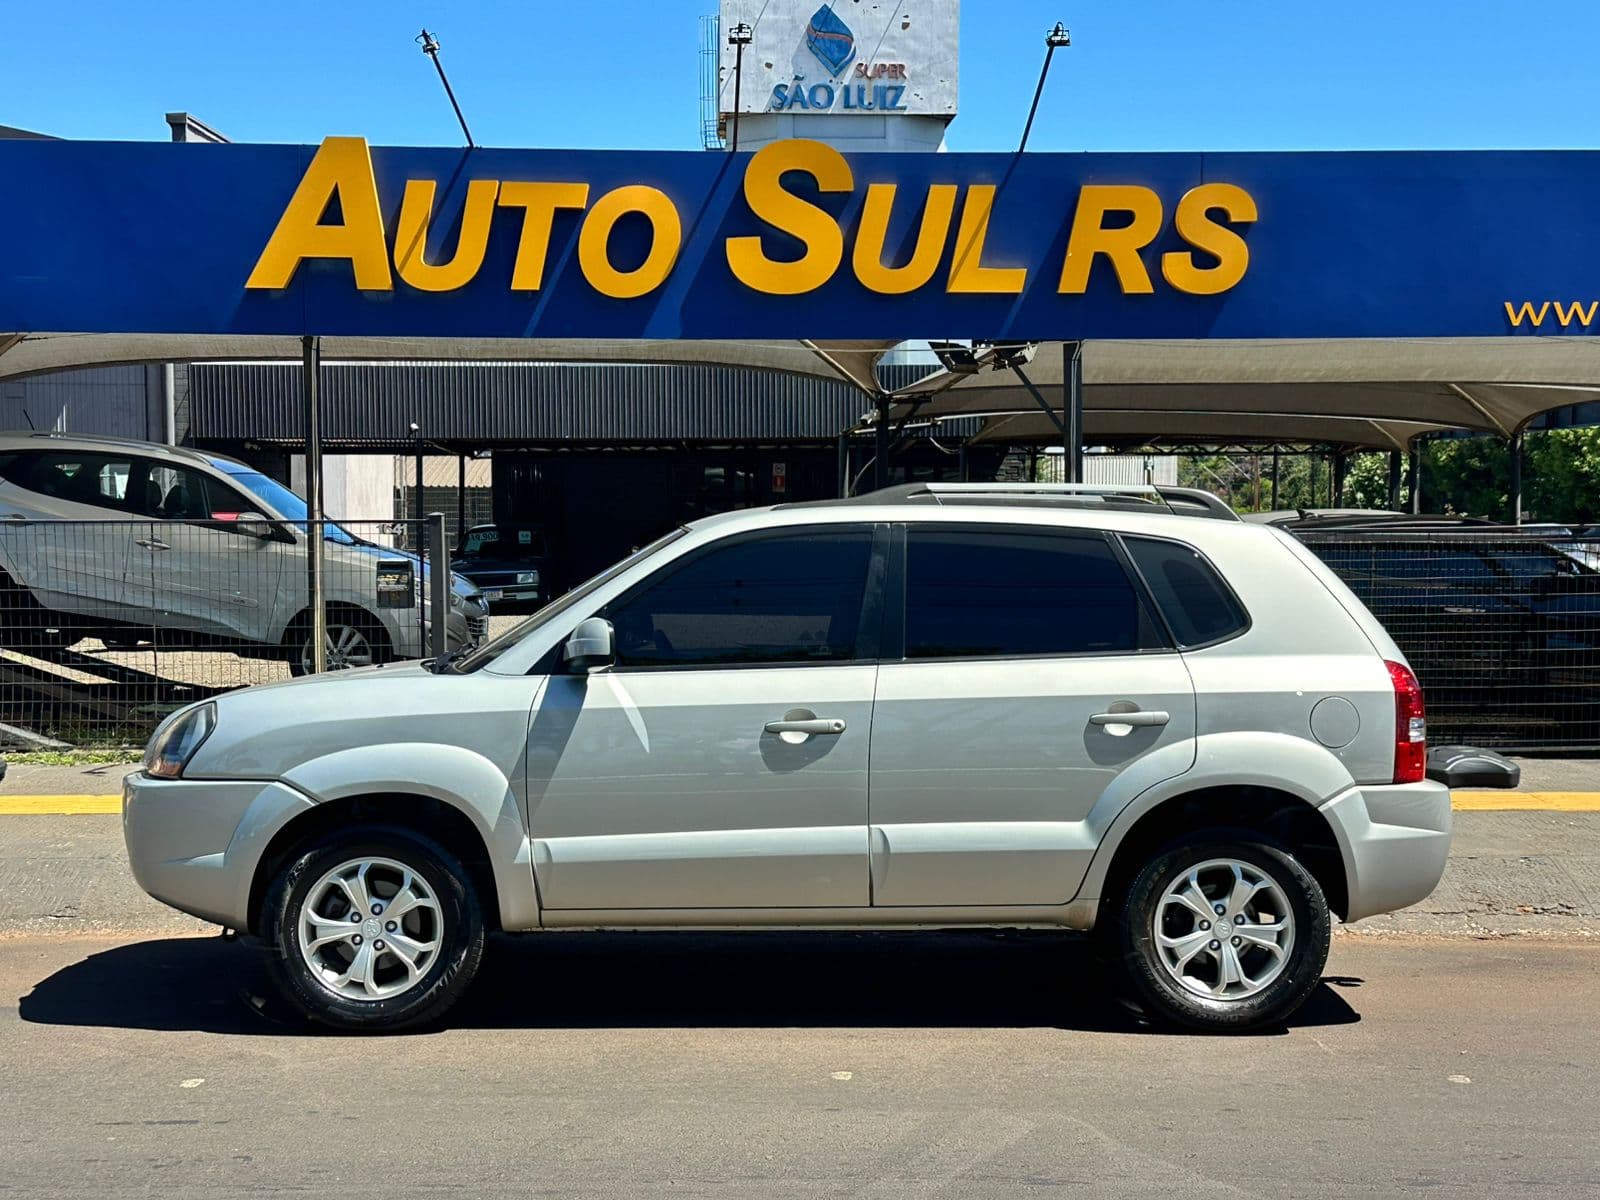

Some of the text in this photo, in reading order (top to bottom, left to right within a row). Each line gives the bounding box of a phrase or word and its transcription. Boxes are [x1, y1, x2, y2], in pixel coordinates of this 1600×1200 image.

[855, 63, 907, 80] SUPER
[771, 75, 907, 111] SÃO LUIZ
[244, 136, 1258, 298] AUTO SUL RS
